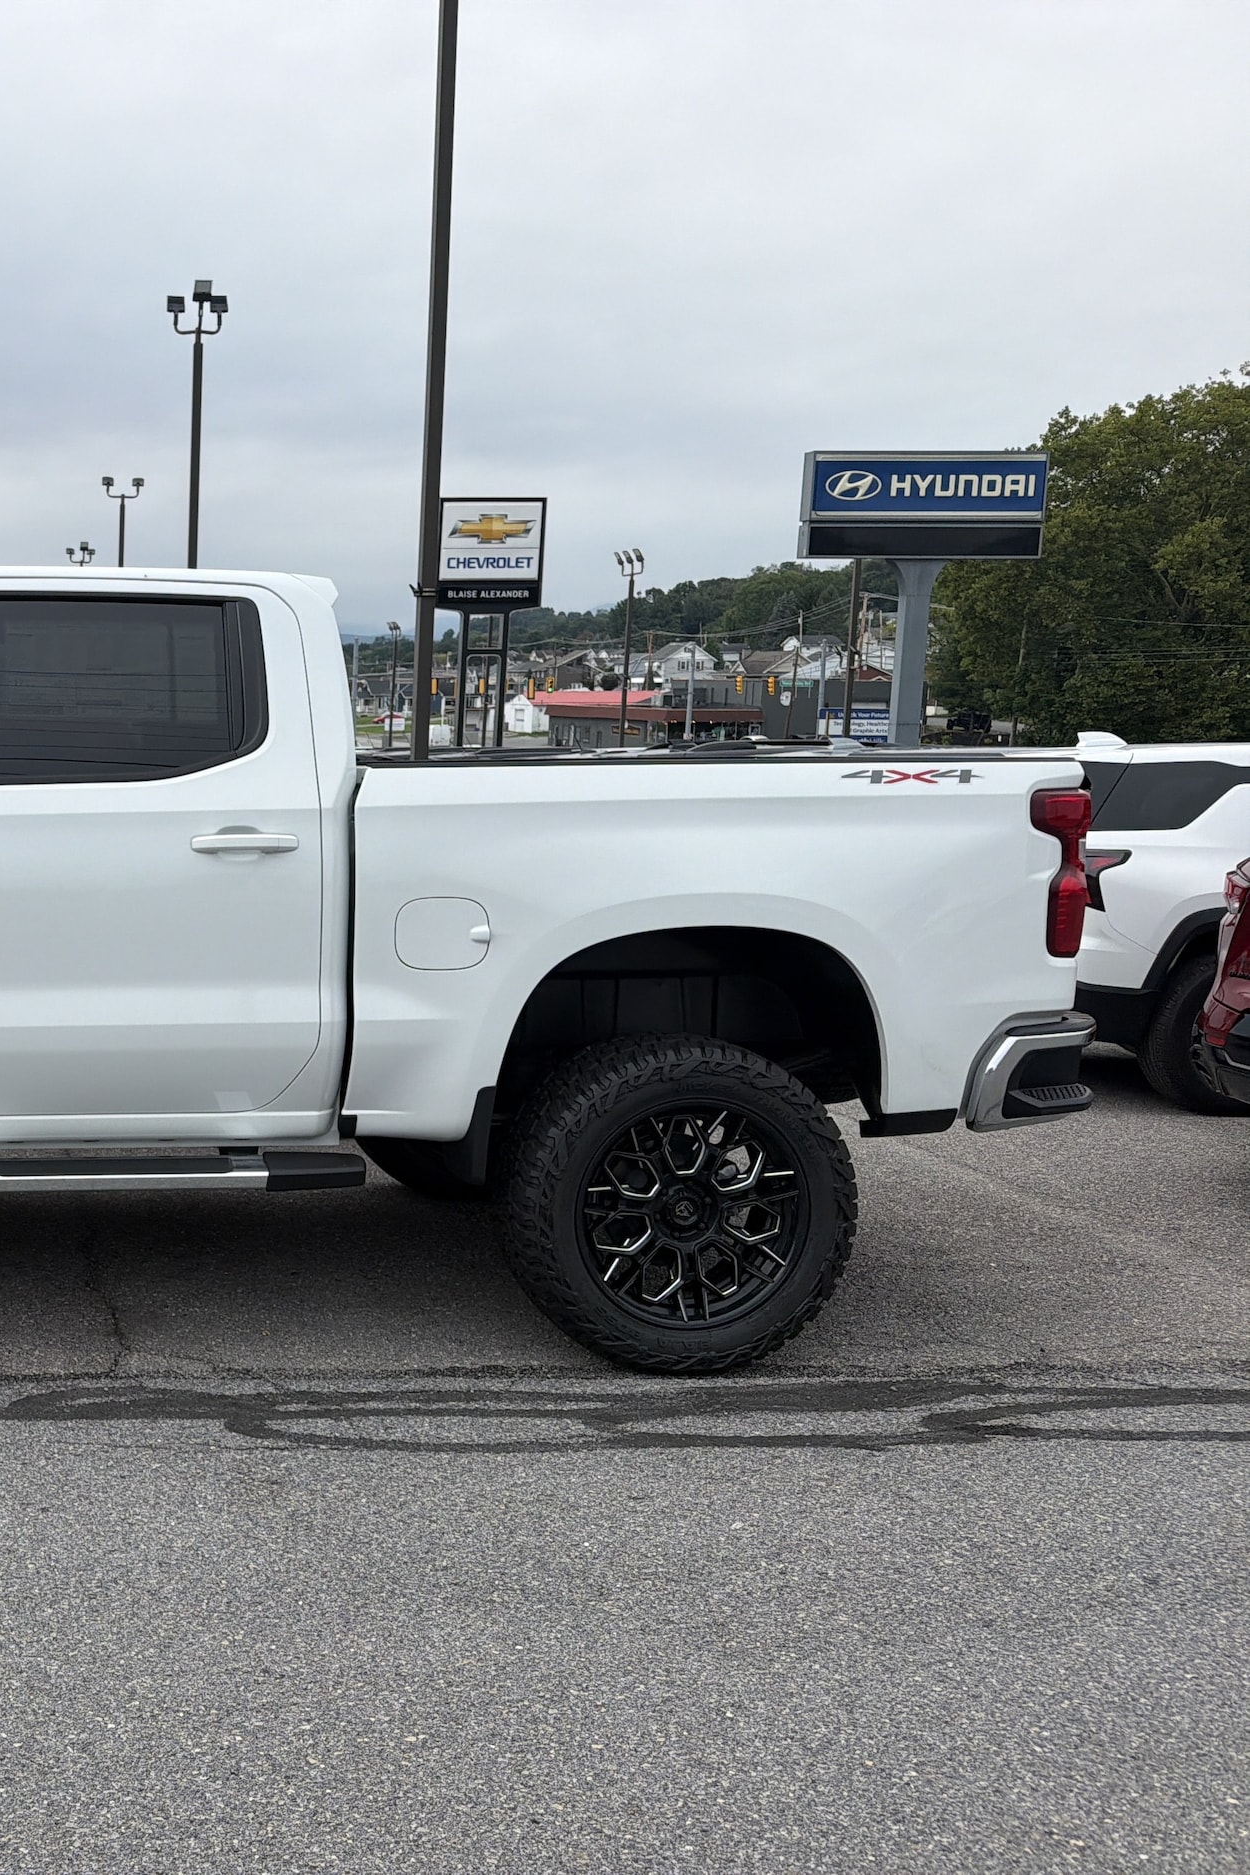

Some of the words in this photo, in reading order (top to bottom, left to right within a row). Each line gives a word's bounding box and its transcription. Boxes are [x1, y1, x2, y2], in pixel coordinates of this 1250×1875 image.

[889, 474, 1037, 498] HYUNDAI
[446, 556, 534, 569] CHEVROLET
[447, 590, 478, 599] BLAISE
[479, 590, 530, 599] ALEXANDER
